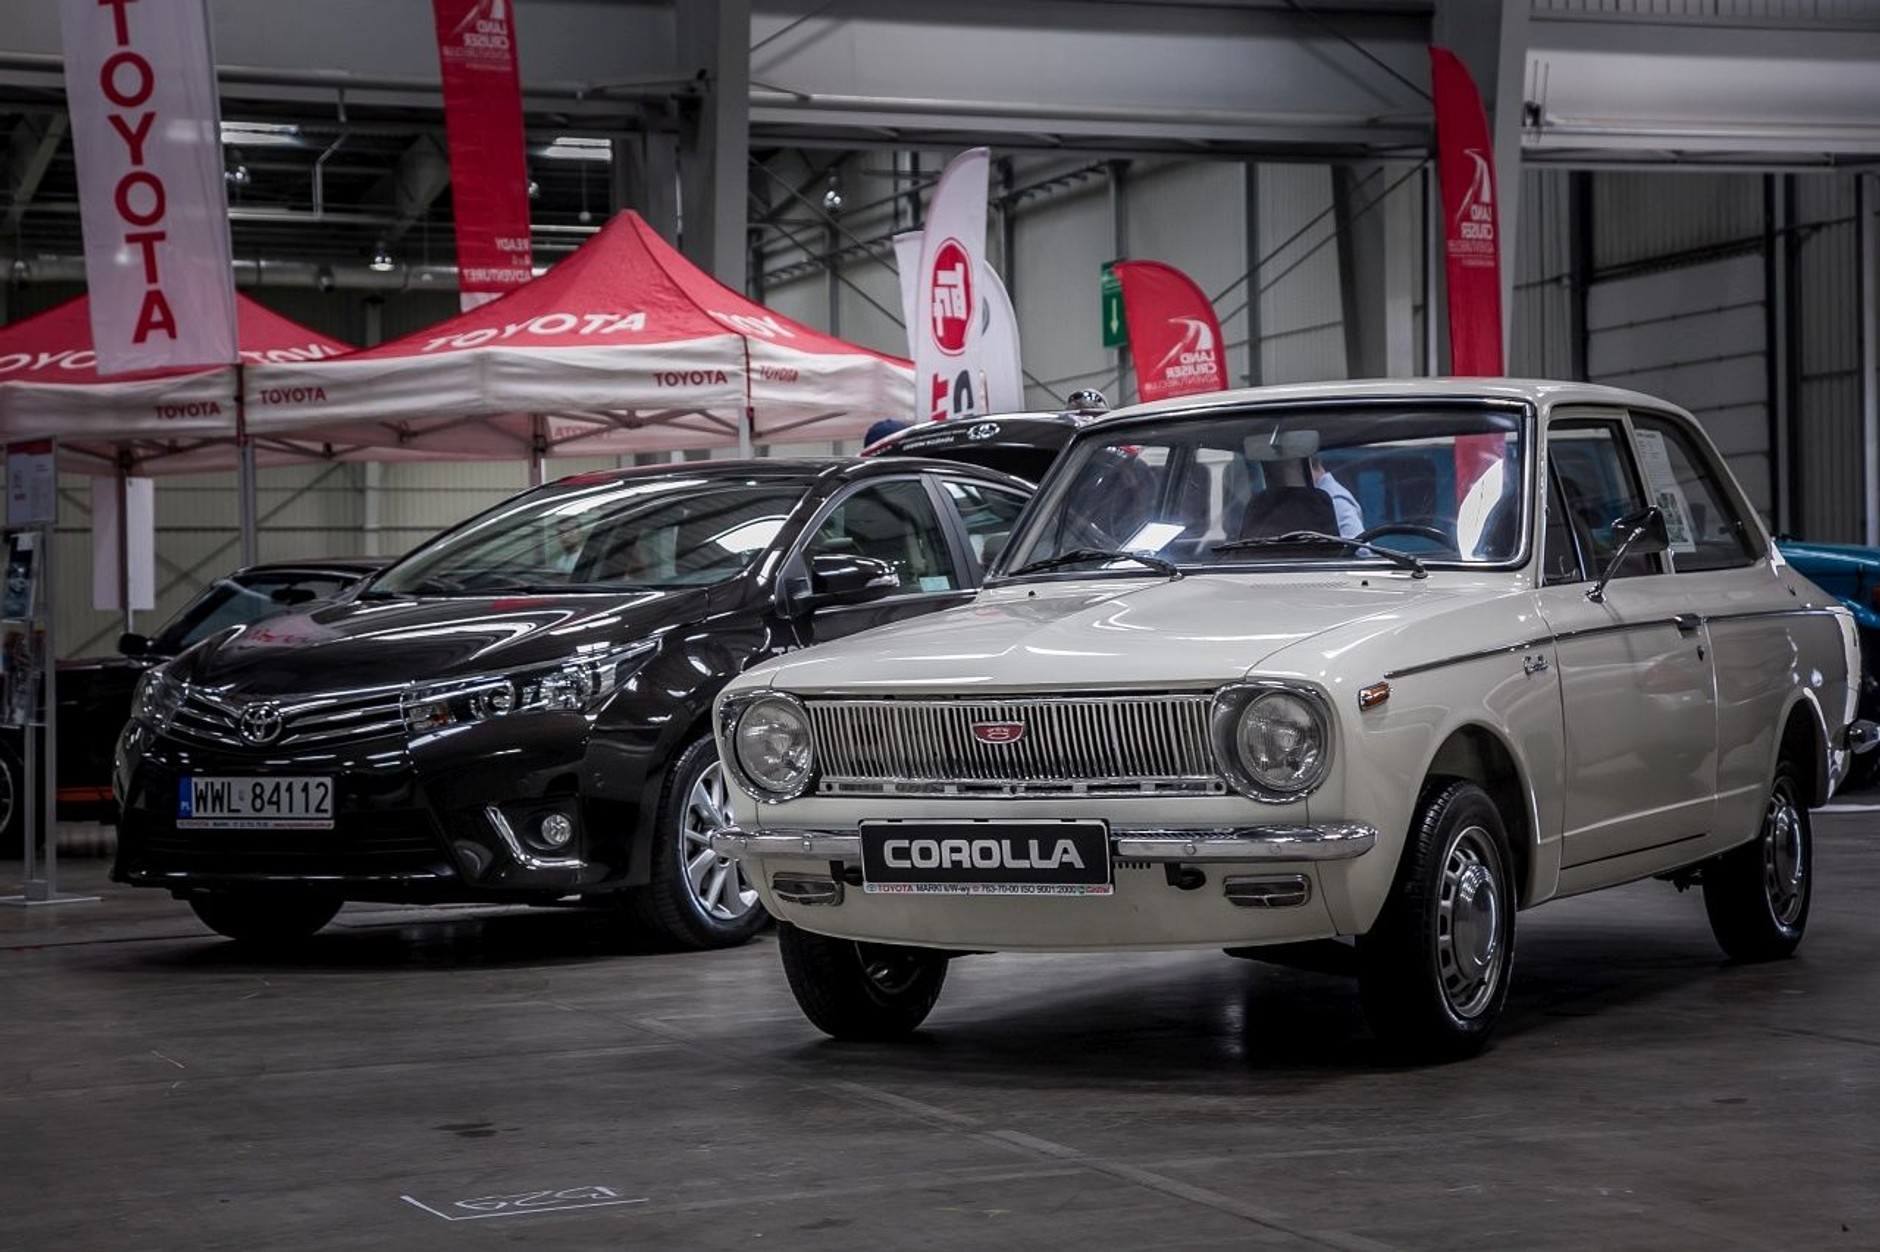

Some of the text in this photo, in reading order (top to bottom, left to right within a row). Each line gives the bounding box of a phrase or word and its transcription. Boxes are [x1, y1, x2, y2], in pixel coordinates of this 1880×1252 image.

[98, 0, 178, 344] TOYOTA
[420, 311, 647, 352] TOYOTA
[652, 369, 729, 388] TOYOTA
[260, 386, 327, 405] TOYOTA
[154, 401, 221, 420] TOYOTA
[193, 781, 330, 814] WWL 84112
[883, 838, 1085, 869] COROLLA
[877, 884, 914, 893] TOYOTA
